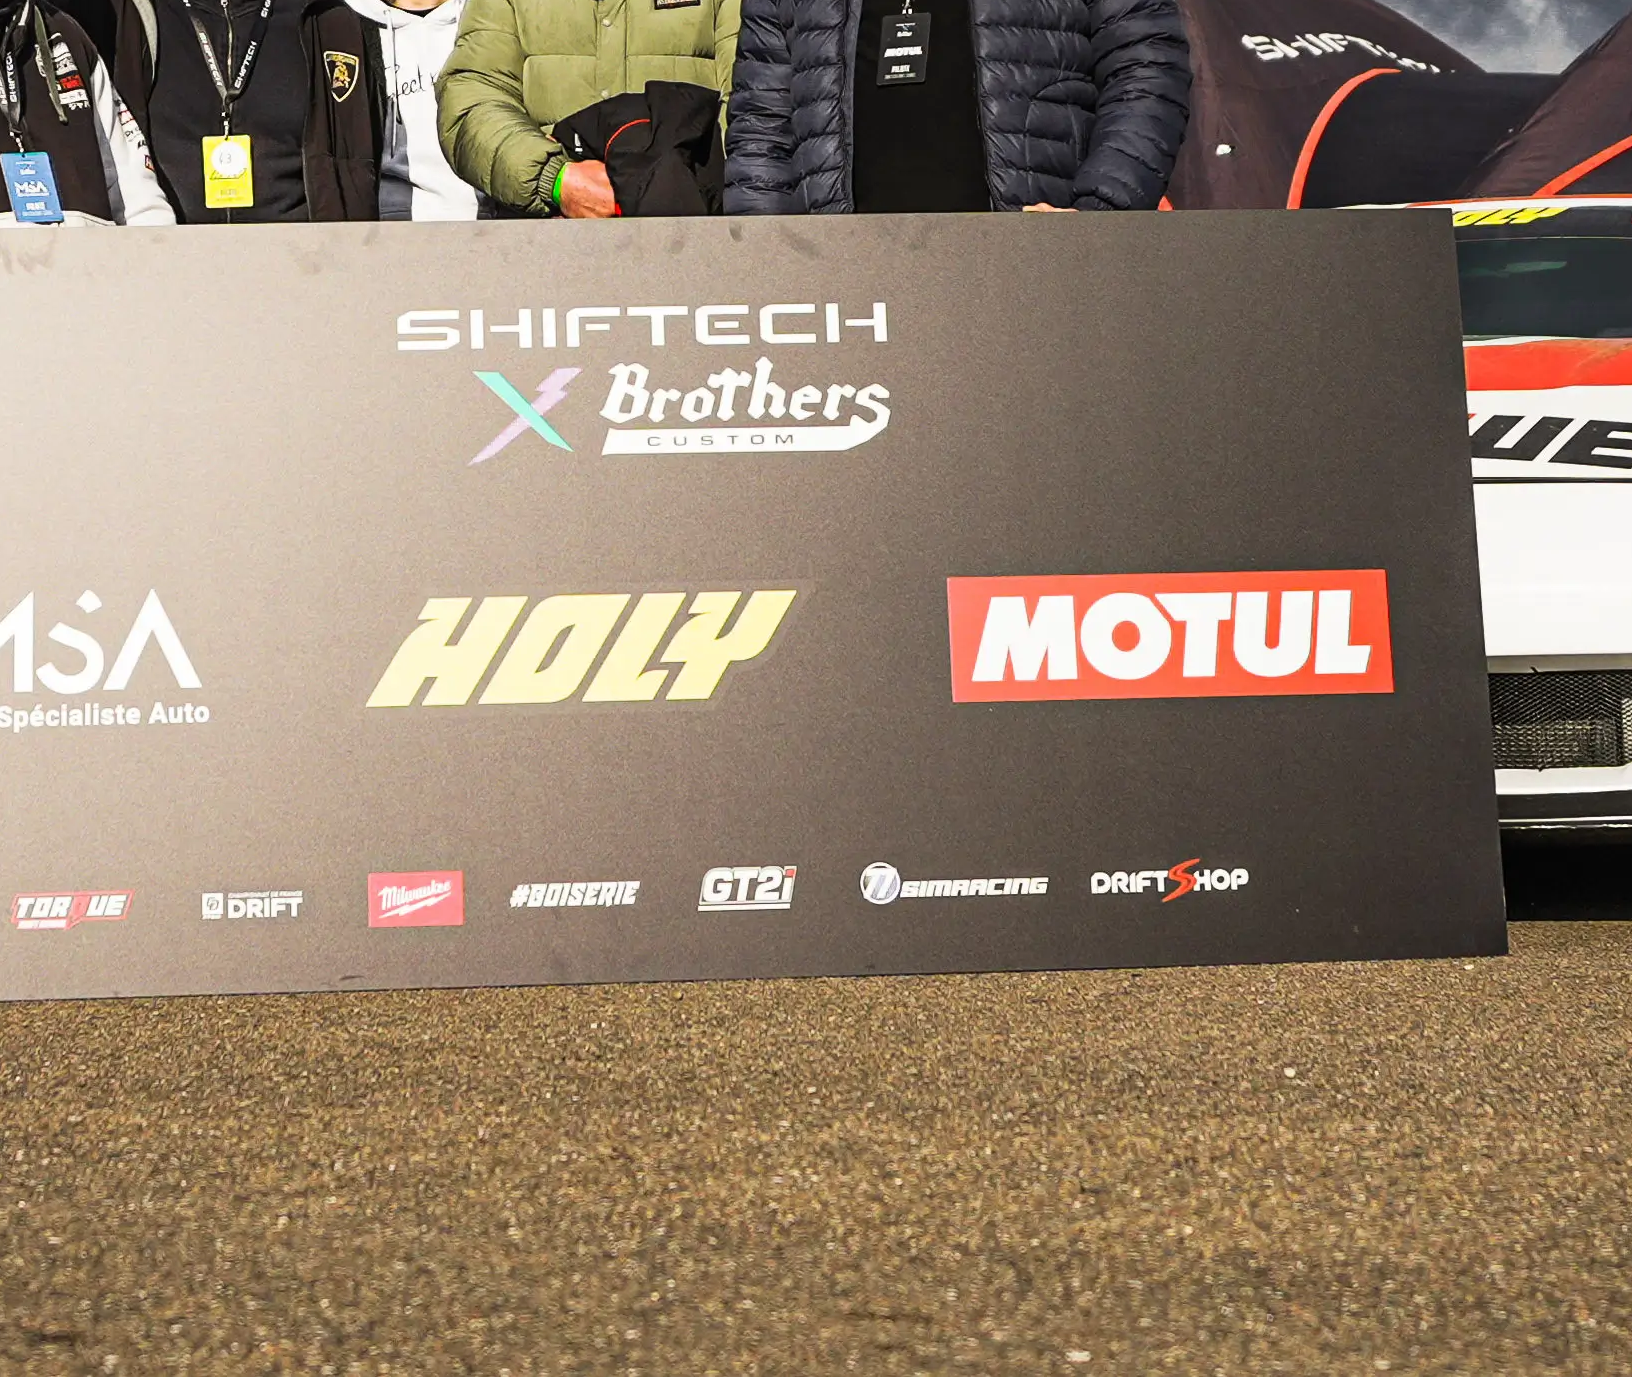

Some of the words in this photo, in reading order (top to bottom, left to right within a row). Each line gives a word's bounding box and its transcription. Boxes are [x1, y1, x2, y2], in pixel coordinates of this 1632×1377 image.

[1452, 207, 1569, 228] OLY
[397, 302, 889, 351] SHIFTECH
[599, 356, 892, 426] Brothers
[646, 433, 795, 447] CUSTOM
[365, 589, 798, 708] HOLY
[971, 589, 1372, 682] MOTUL
[148, 702, 210, 724] Auto
[378, 879, 452, 910] Milwaukee
[509, 881, 641, 909] #BOISERIE
[701, 866, 797, 903] GT2i
[1090, 858, 1249, 902] DRIFTSHOP
[16, 895, 128, 922] TORQUE
[227, 897, 304, 919] DRIFT
